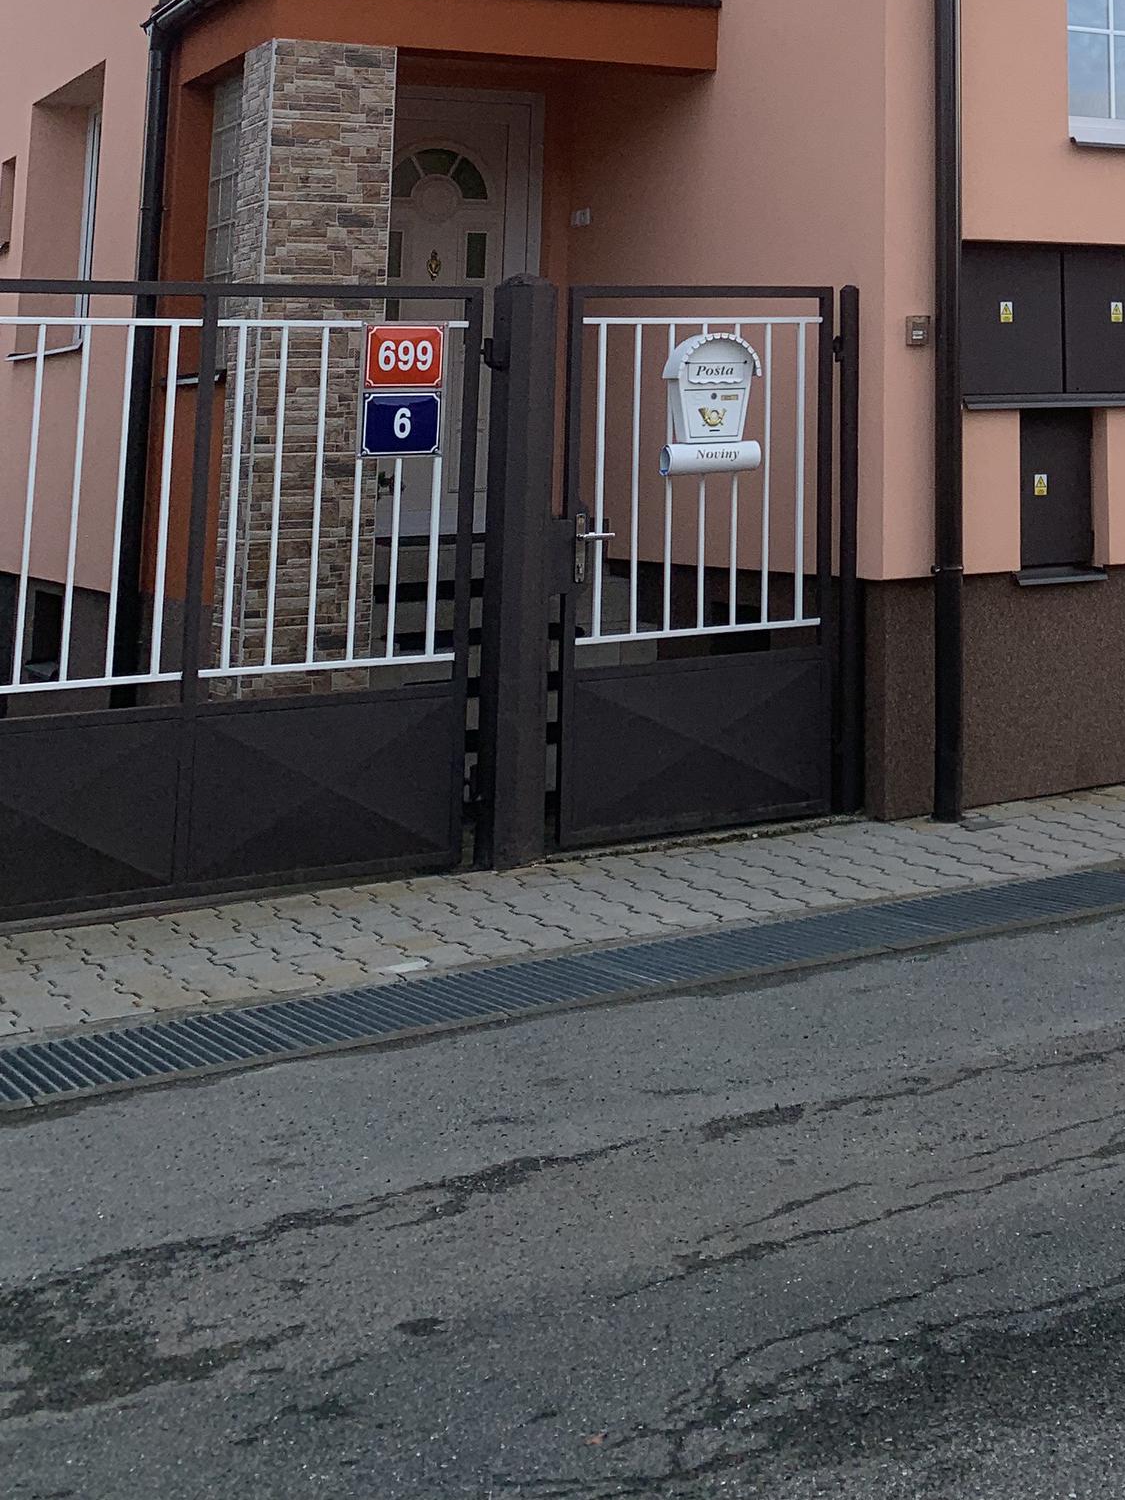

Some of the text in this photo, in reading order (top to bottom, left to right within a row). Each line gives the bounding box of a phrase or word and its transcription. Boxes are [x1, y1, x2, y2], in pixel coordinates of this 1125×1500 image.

[378, 340, 433, 372] 699
[393, 407, 412, 439] 6
[696, 449, 740, 462] Noviny
